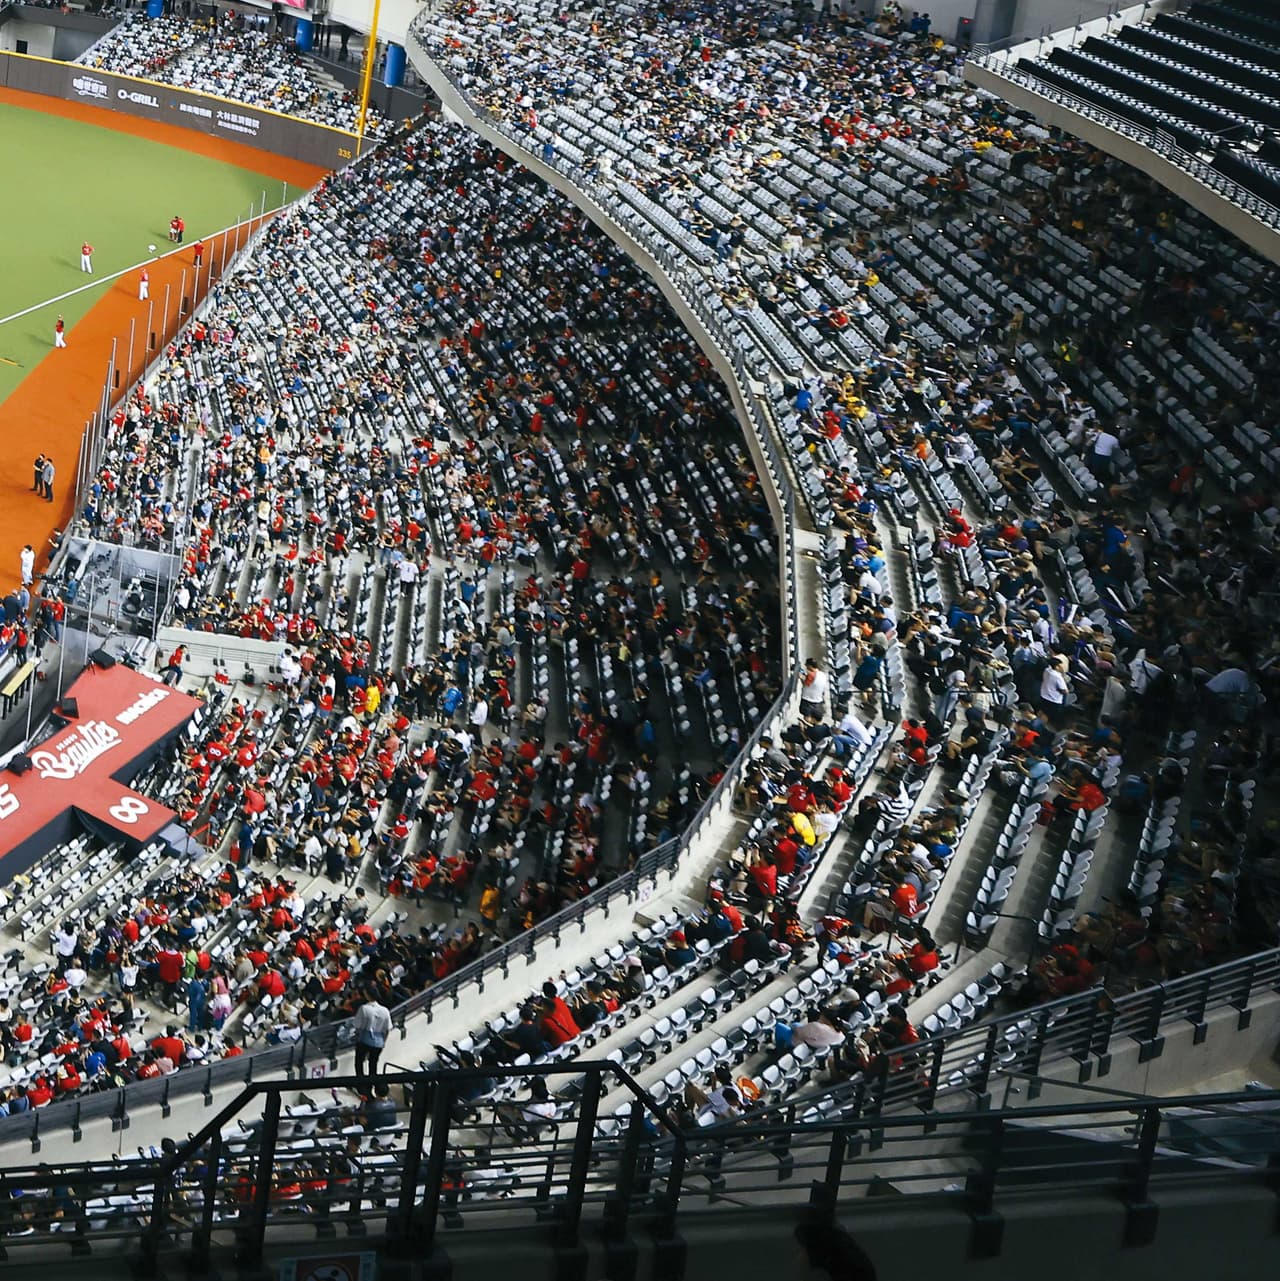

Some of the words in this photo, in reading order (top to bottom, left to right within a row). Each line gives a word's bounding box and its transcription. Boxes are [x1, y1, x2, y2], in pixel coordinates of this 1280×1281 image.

[117, 89, 160, 108] O-GRILL
[337, 147, 352, 159] 335
[30, 718, 124, 780] Beauties
